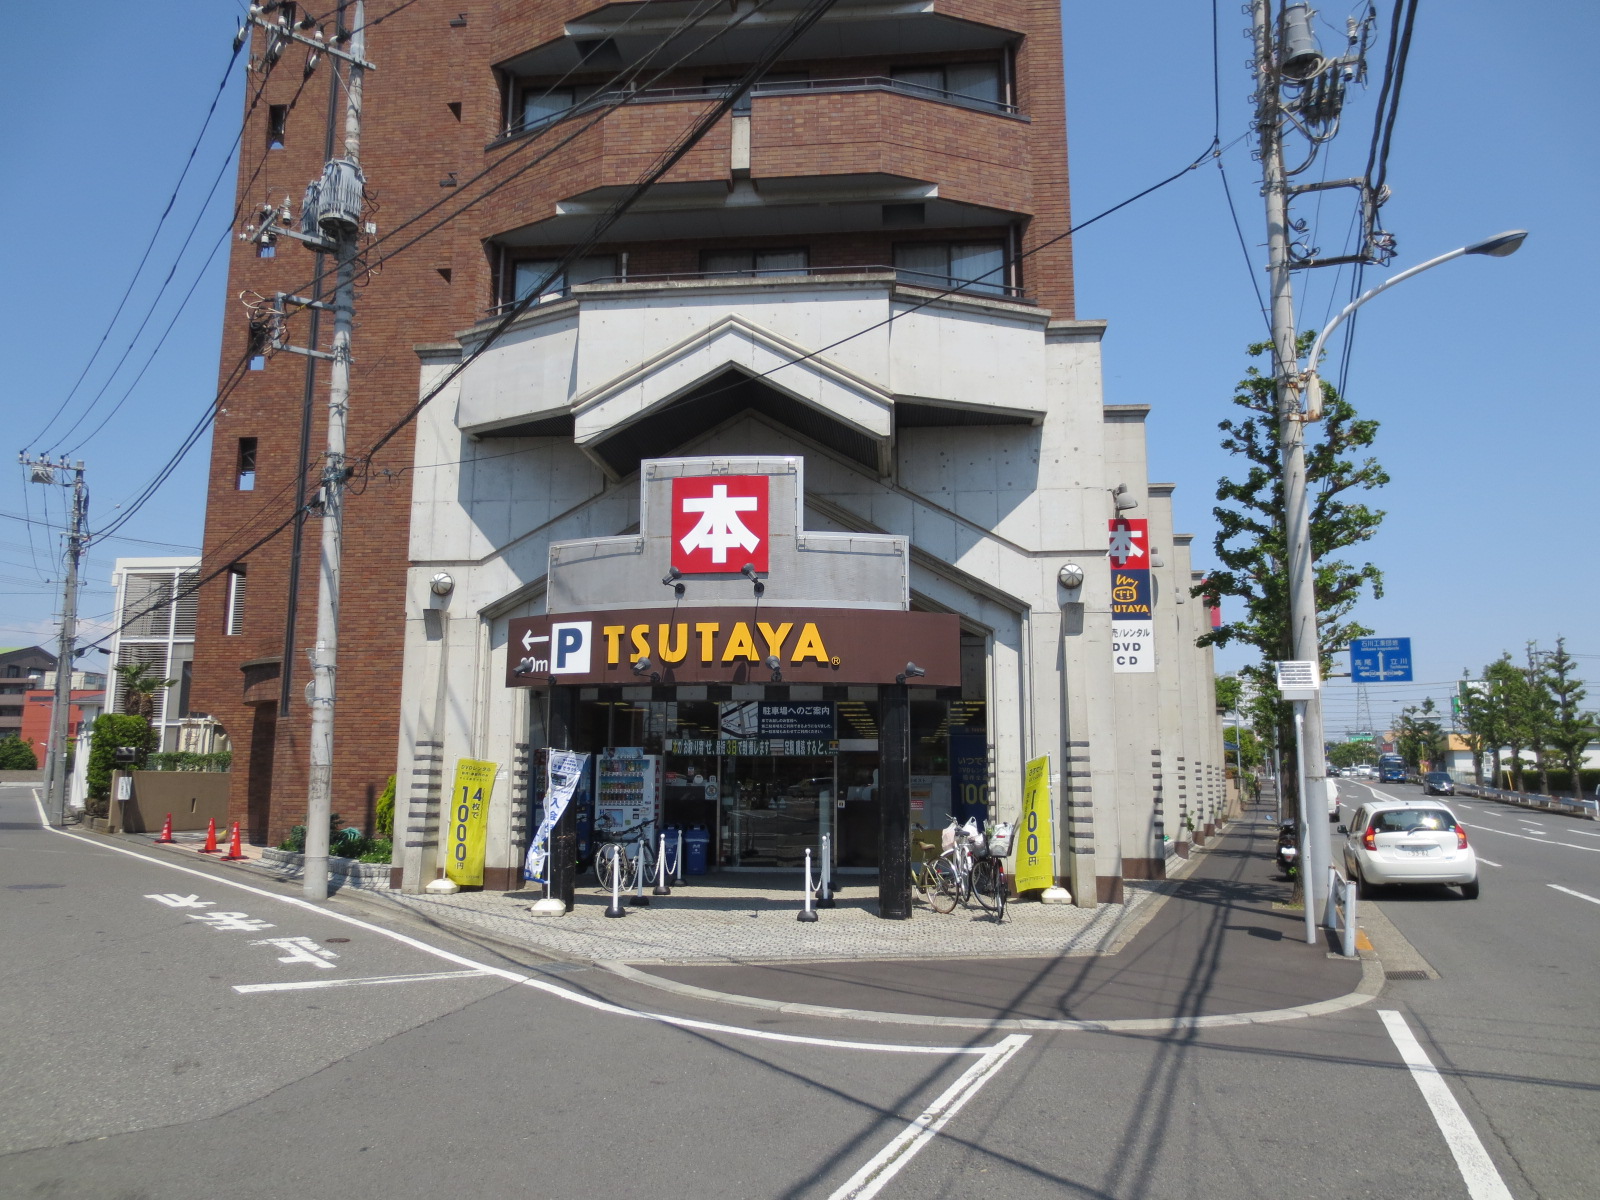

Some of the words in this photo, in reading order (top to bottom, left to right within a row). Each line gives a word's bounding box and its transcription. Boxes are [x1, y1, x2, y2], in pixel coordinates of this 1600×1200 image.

[680, 484, 760, 563] 本
[1106, 524, 1144, 565] 本
[1112, 604, 1148, 613] UTAYA
[556, 628, 583, 669] P
[603, 621, 829, 664] TSUTAYA
[1112, 642, 1141, 652] DVD
[1116, 656, 1138, 665] CD
[762, 706, 830, 716] 駐車場へのご案内
[455, 786, 469, 870] 1000円
